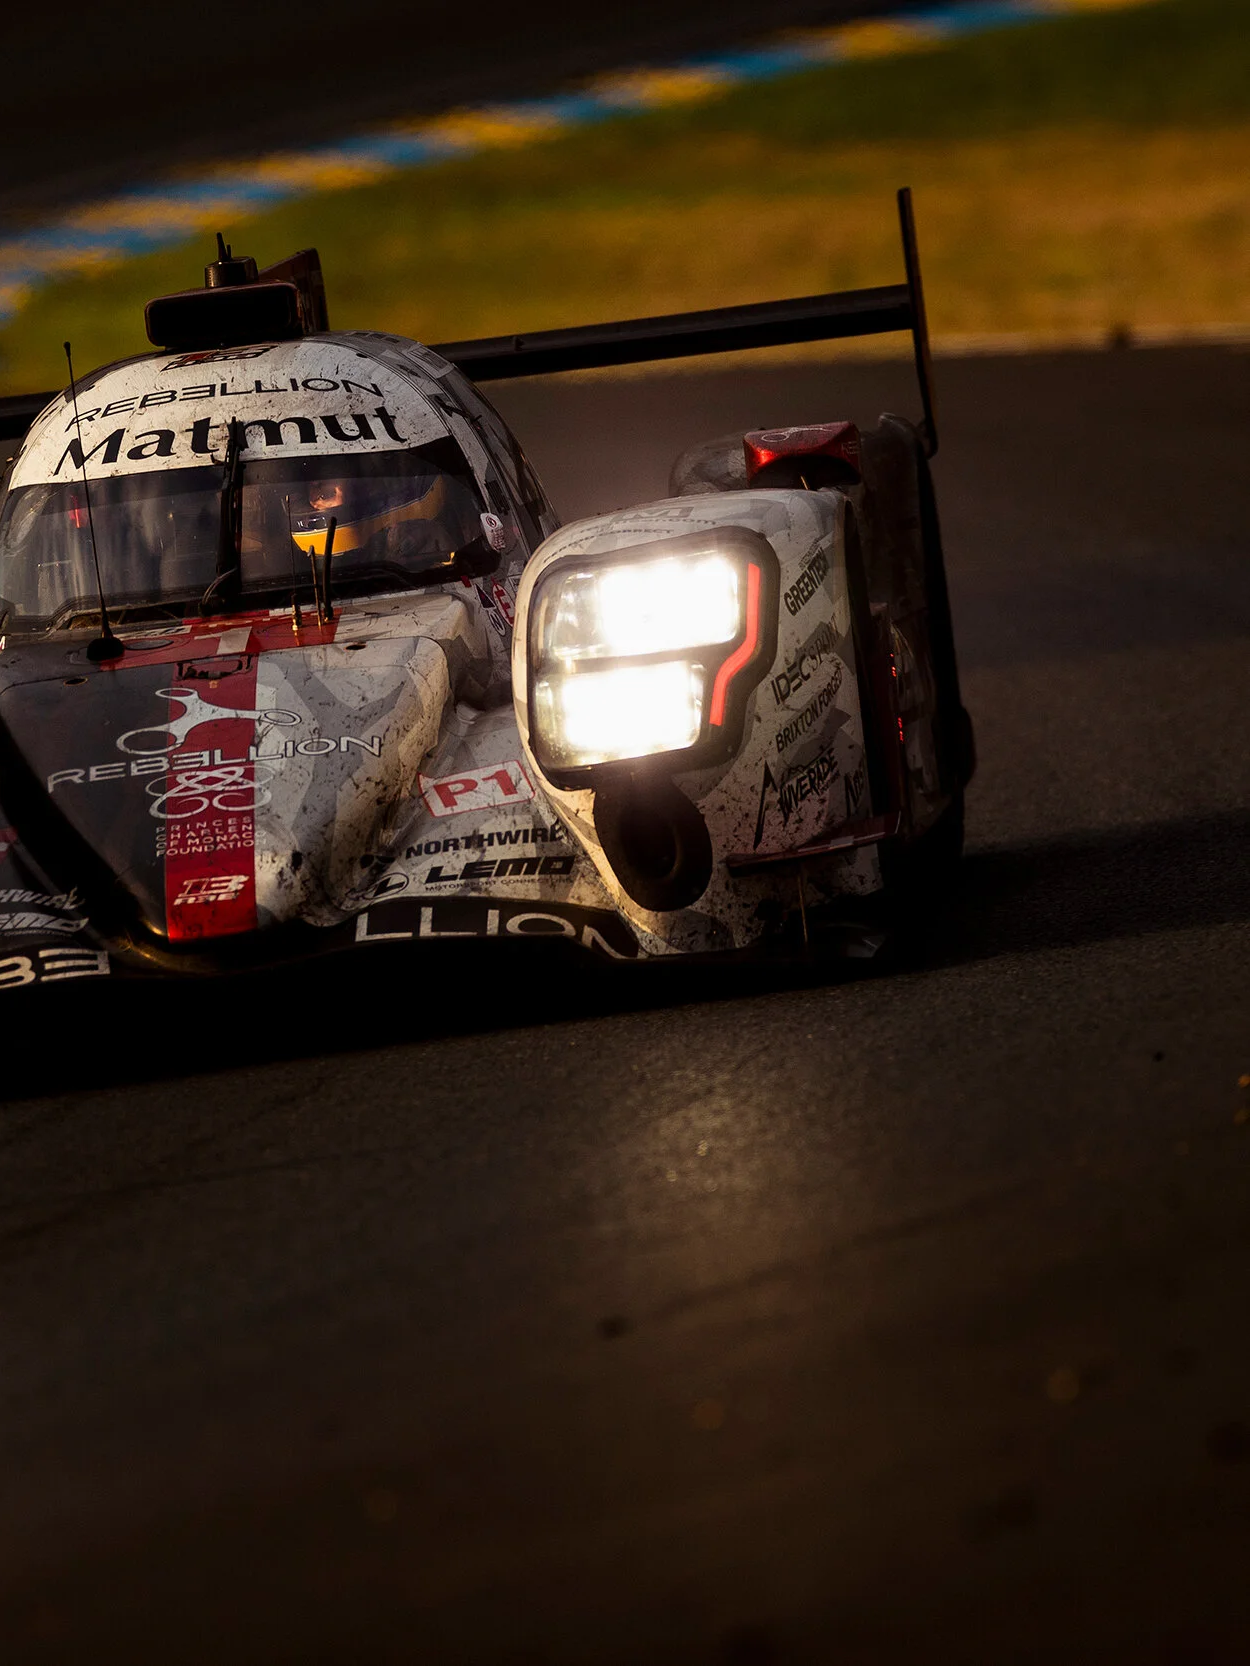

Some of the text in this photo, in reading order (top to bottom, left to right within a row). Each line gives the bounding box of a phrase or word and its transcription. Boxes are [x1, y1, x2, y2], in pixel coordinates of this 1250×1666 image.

[65, 377, 386, 431] REBELLION
[53, 406, 408, 476] Matmut
[776, 702, 819, 753] BRIXTON
[47, 735, 382, 793] REBELLION
[433, 769, 518, 808] P1
[406, 820, 570, 859] NORTHWIRE
[425, 856, 575, 884] LEMO
